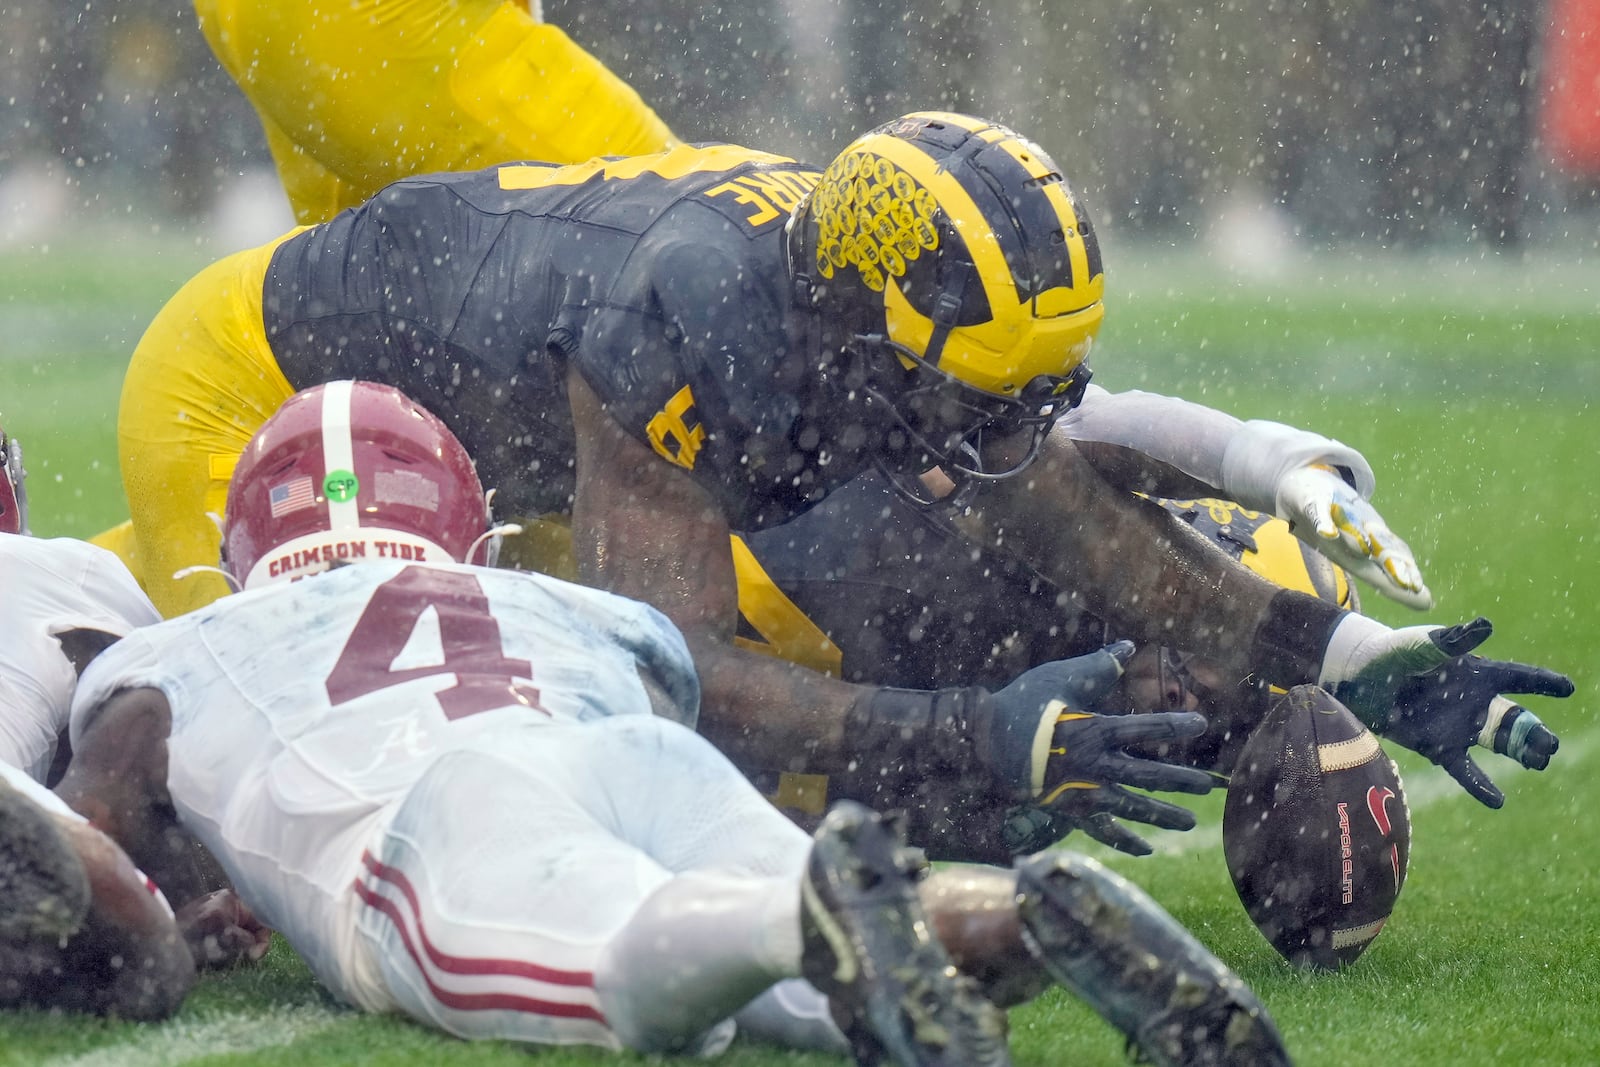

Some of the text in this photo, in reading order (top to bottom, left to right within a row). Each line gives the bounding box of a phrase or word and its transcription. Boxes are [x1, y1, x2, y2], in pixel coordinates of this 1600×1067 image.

[269, 541, 366, 577] CRIMSON
[374, 541, 427, 562] TIDE
[325, 565, 552, 721] 4
[1337, 802, 1353, 904] VAPOR ELITE
